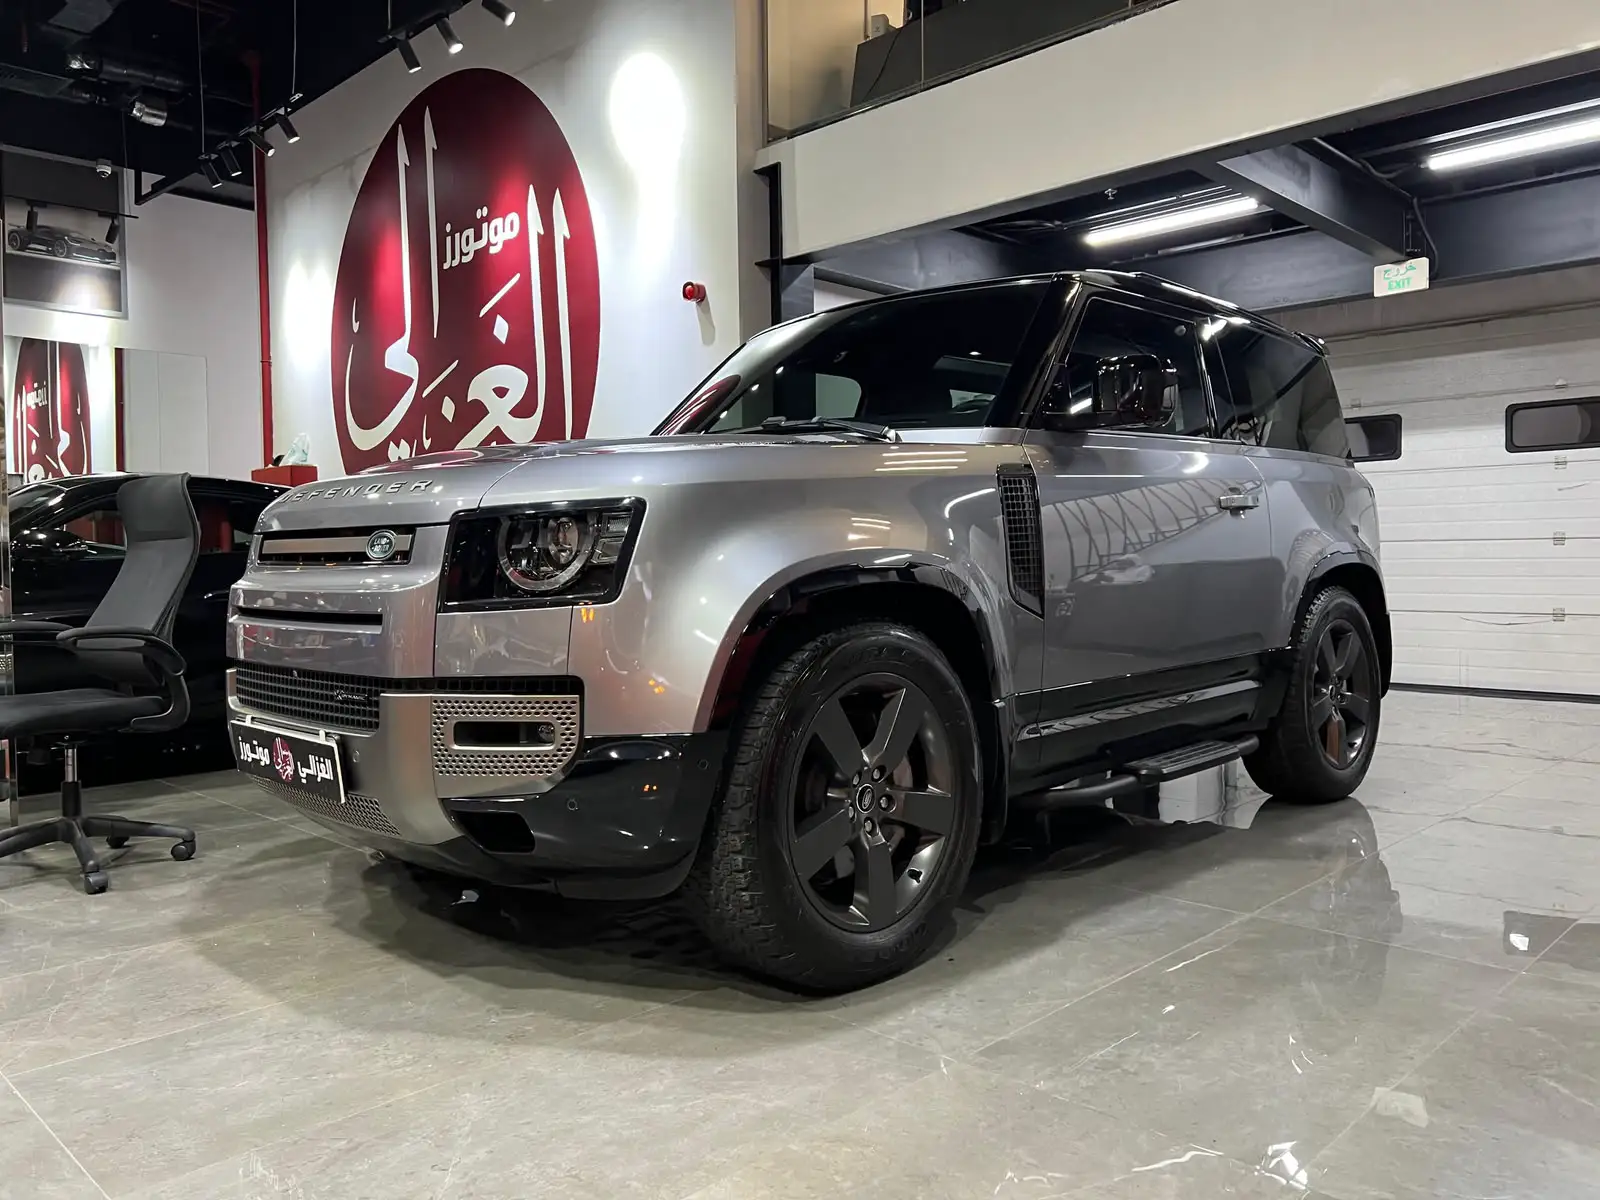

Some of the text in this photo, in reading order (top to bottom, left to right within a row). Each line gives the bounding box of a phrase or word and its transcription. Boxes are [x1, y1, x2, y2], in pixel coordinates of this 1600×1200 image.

[442, 206, 520, 270] موتورز
[1383, 262, 1417, 281] خروج
[1387, 278, 1413, 291] EXIT
[279, 479, 433, 504] DEFENDER
[238, 736, 334, 784] الغزالي موتورز
